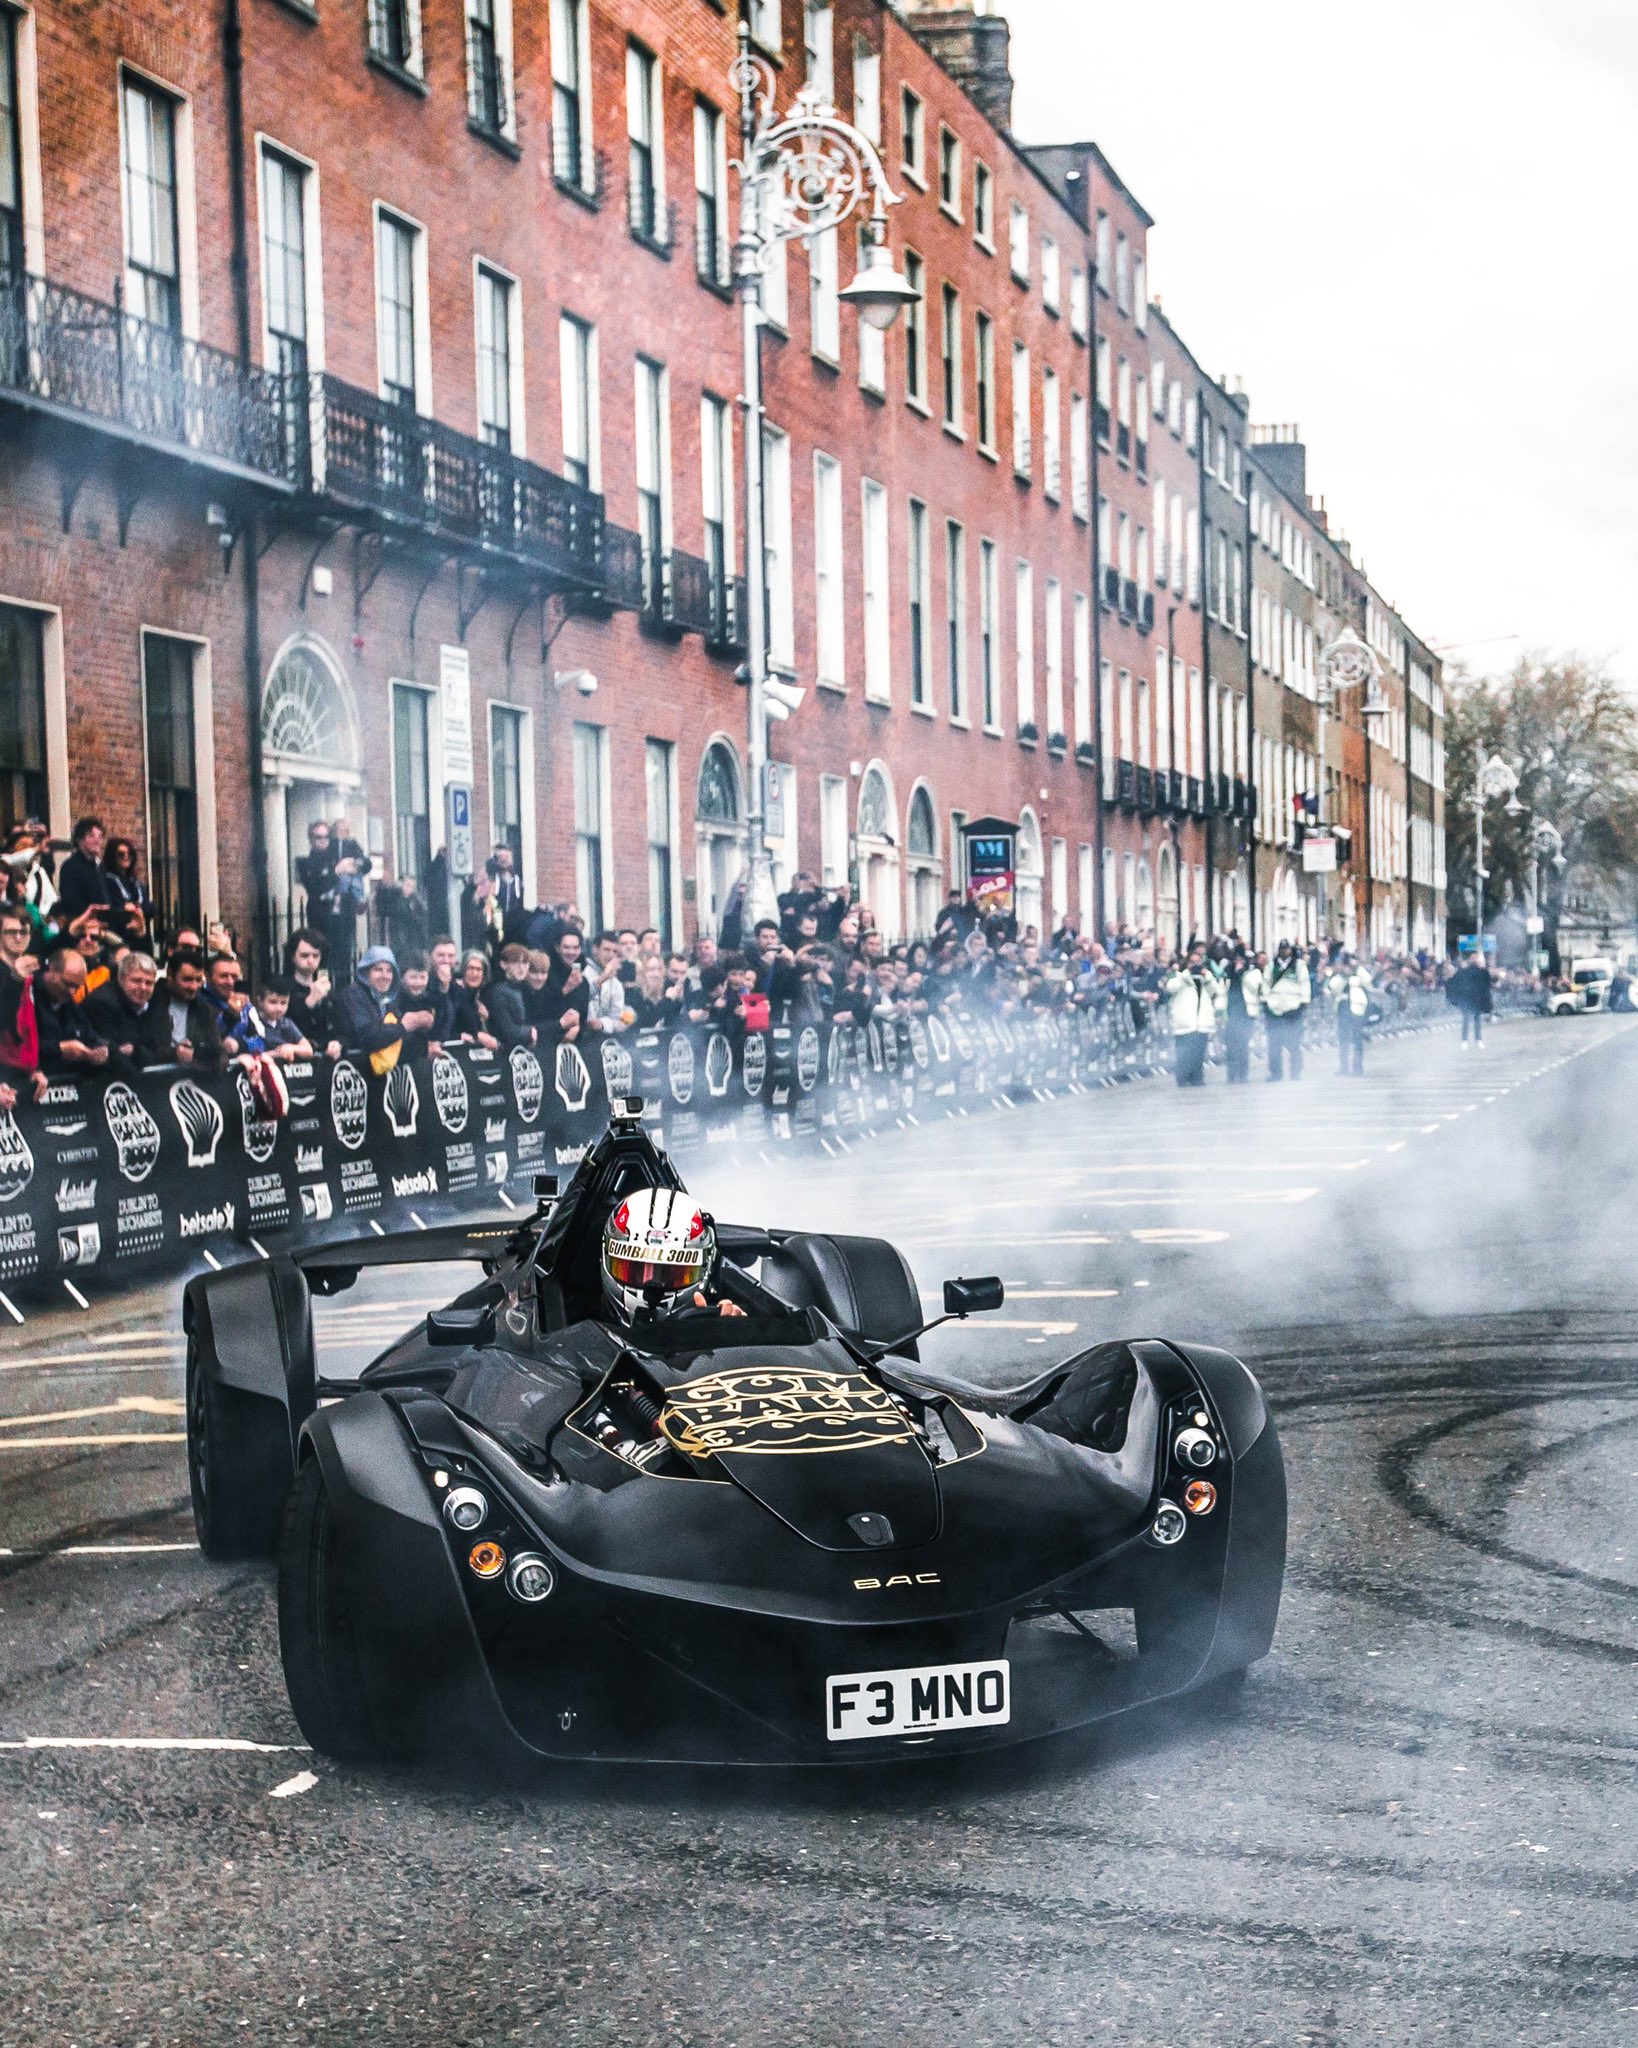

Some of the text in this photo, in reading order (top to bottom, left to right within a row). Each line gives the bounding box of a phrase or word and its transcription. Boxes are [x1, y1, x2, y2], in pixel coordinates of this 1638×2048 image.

[456, 793, 467, 821] P
[608, 1240, 699, 1264] GUMBALL 3000
[853, 1573, 941, 1590] BAC
[832, 1669, 1004, 1730] F3 MNO
